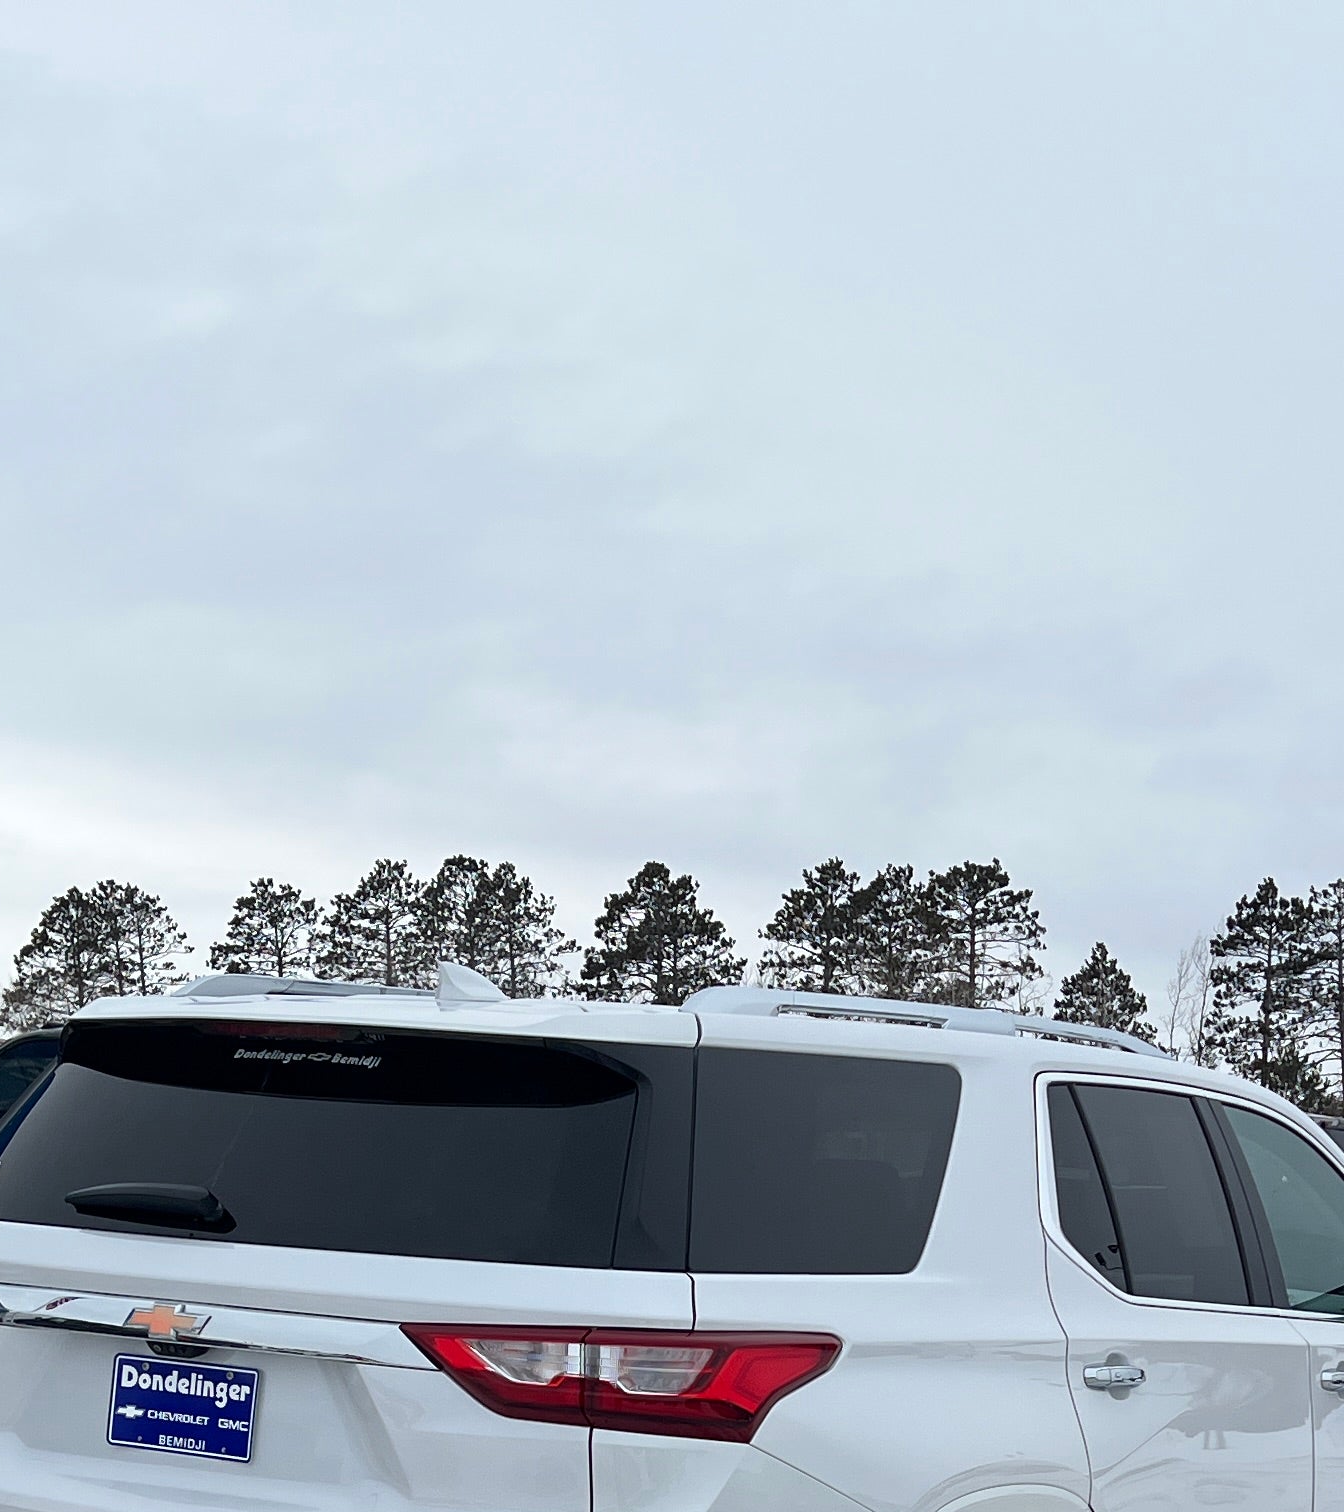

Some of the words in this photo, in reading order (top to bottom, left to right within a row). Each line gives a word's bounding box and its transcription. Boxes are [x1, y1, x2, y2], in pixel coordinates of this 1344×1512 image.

[233, 1048, 306, 1064] Dondelinger
[331, 1052, 382, 1069] Bemidji
[120, 1364, 251, 1409] Dondelinger
[147, 1409, 210, 1426] CHEVROLET
[217, 1418, 249, 1432] GMC
[158, 1434, 206, 1451] BEMIDJI
